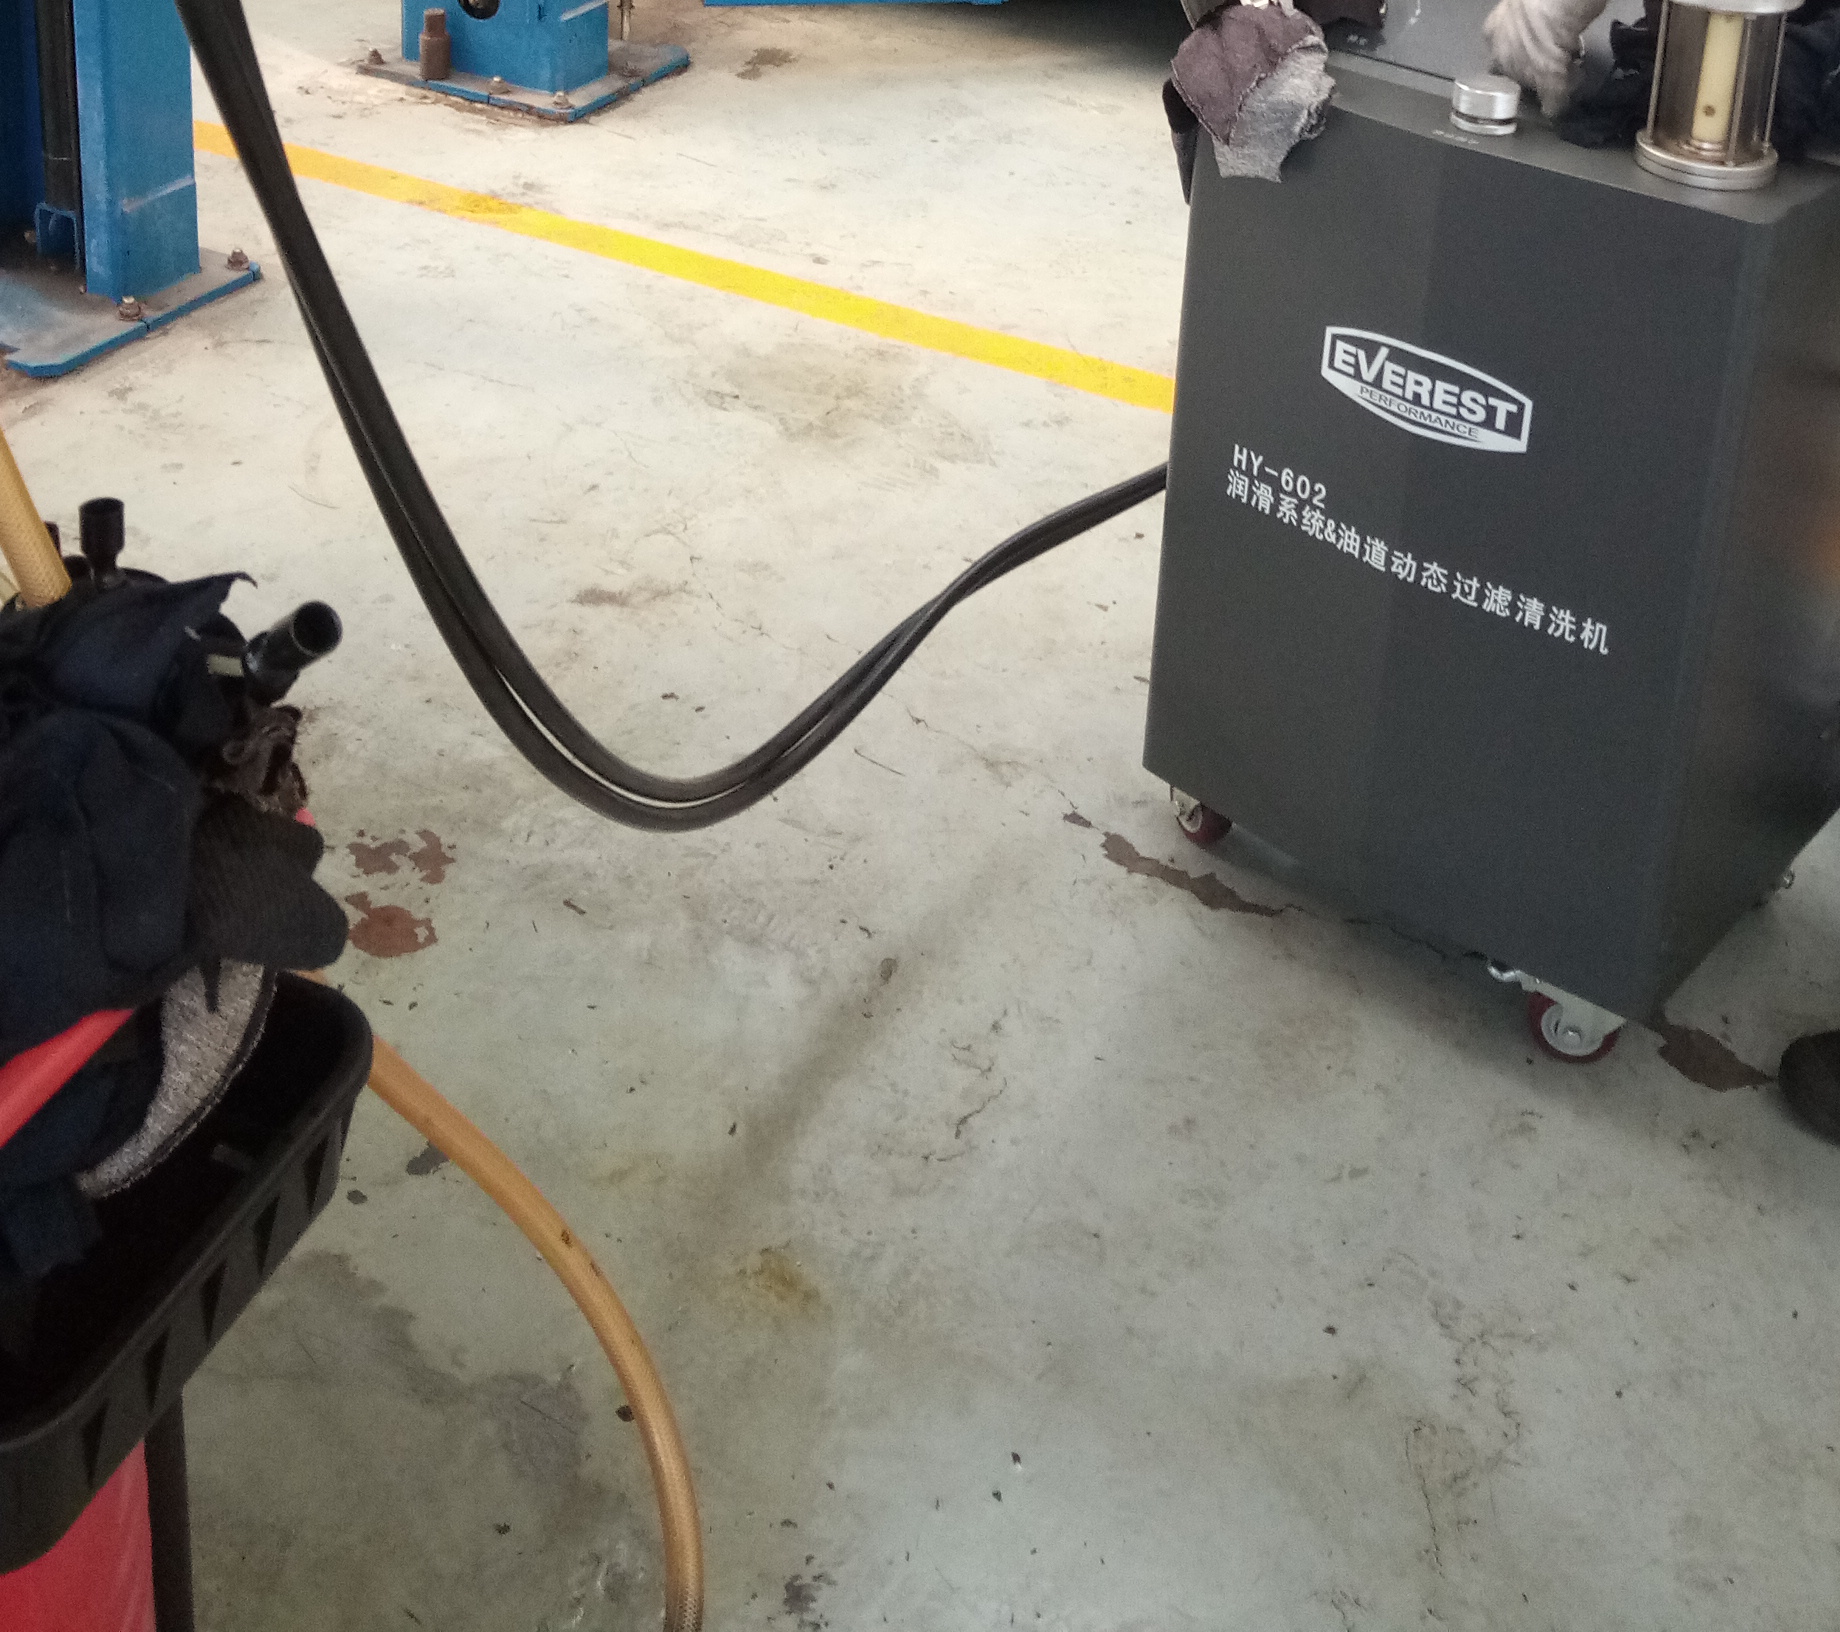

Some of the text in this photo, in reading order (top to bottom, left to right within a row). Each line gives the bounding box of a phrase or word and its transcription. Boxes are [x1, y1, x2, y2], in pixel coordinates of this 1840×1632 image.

[1334, 339, 1518, 431] EVEREST
[1359, 385, 1479, 439] PERFORMANCE
[1233, 444, 1326, 508] HY-602
[1226, 468, 1609, 655] 润滑系统&油道动态过滤清洗机
